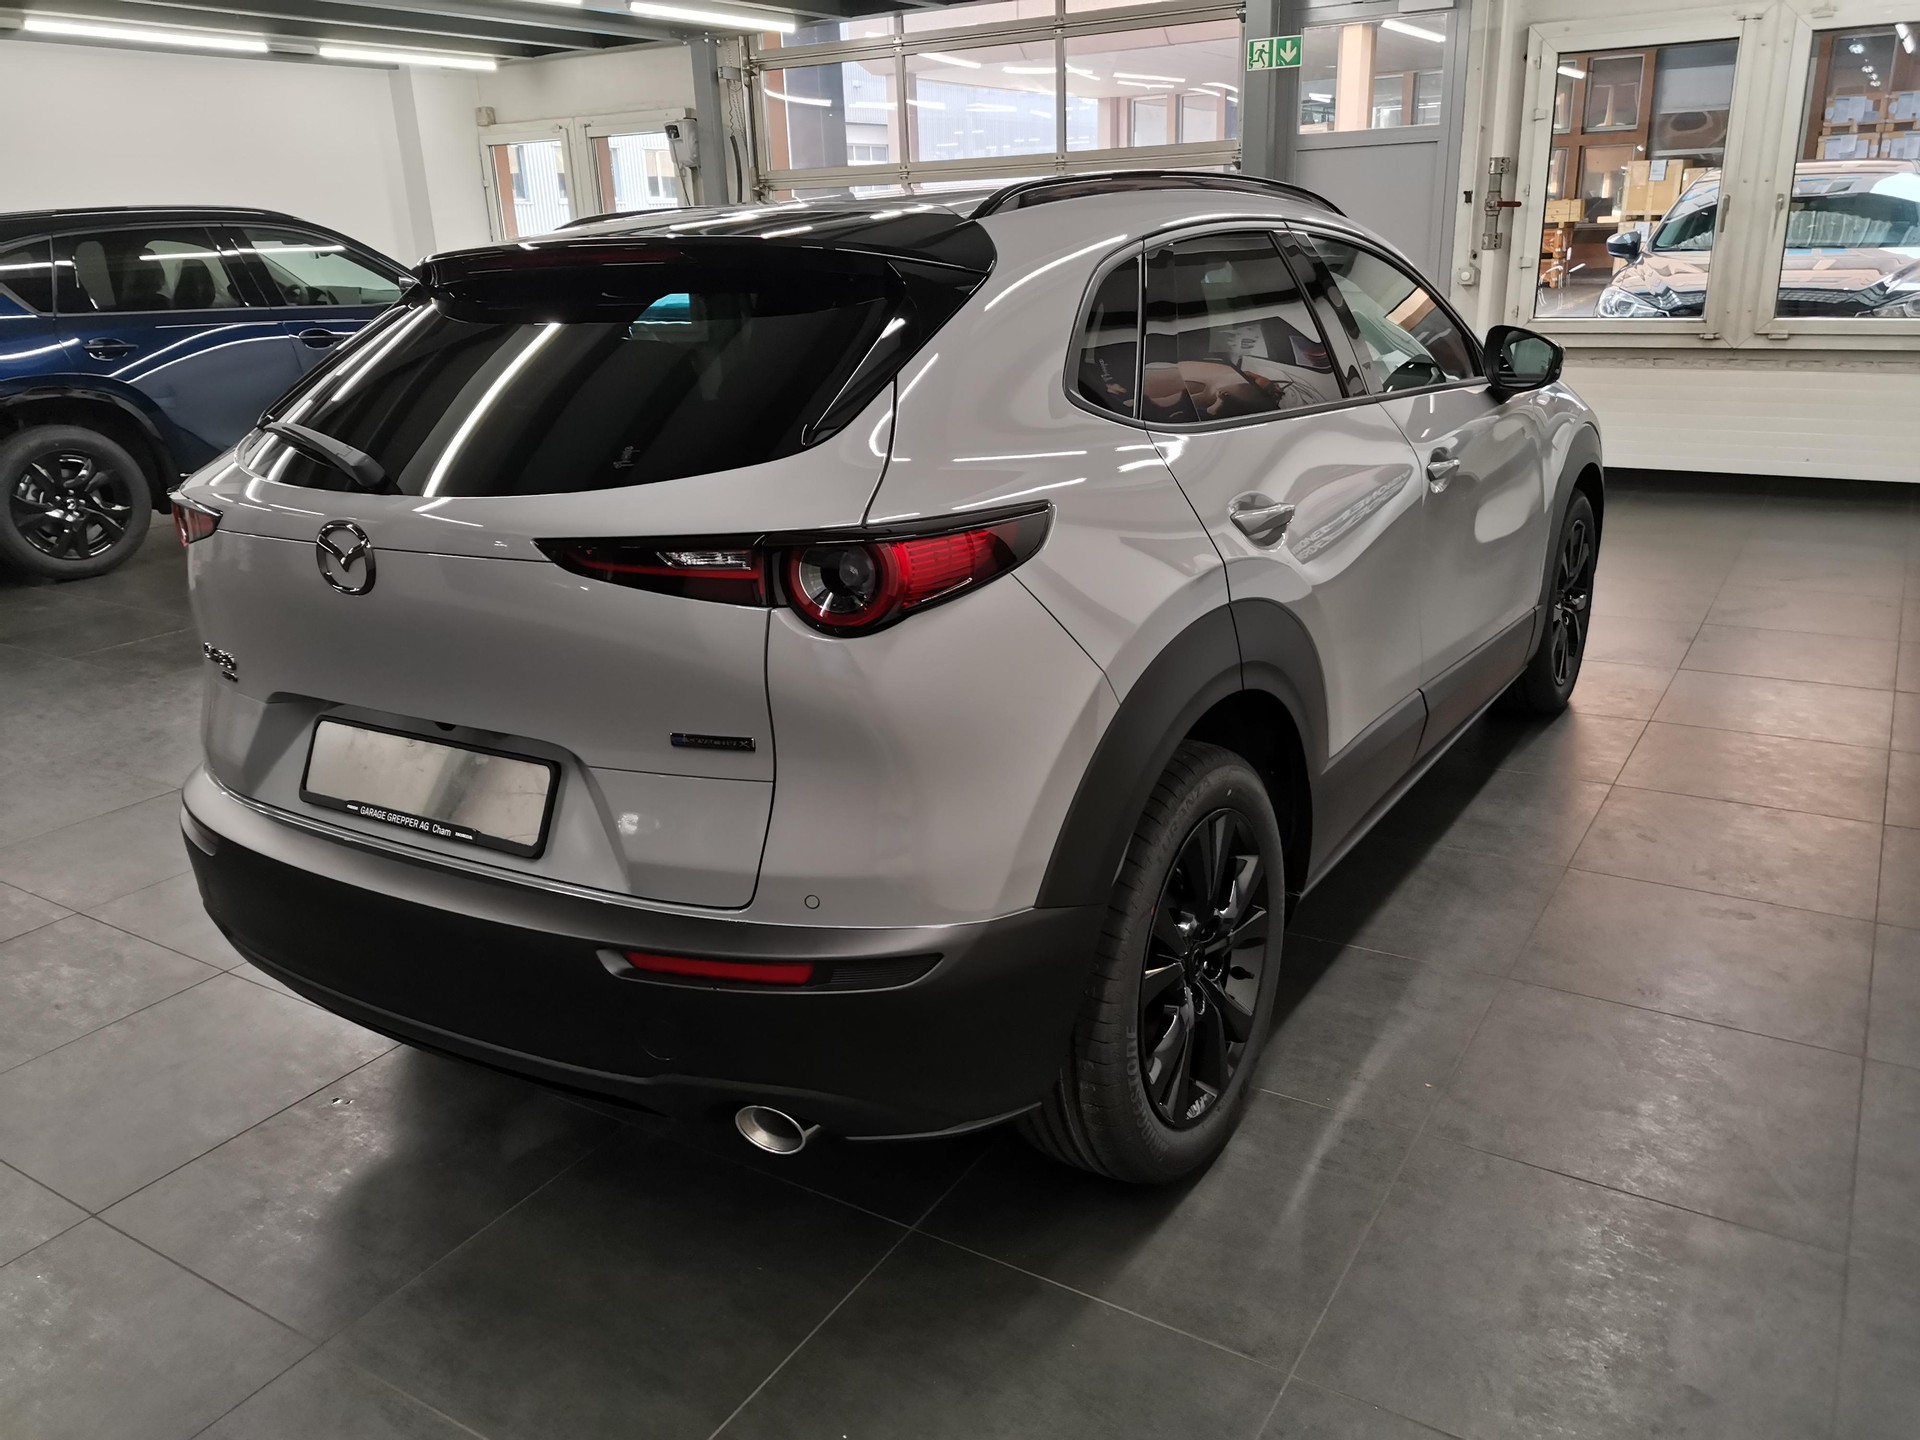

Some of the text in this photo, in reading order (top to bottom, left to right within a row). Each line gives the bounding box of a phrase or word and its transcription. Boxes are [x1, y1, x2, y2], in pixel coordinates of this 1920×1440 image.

[360, 806, 387, 820] GARAGE
[387, 813, 419, 828] GREPPER
[419, 821, 430, 831] AG
[432, 823, 452, 837] Cham
